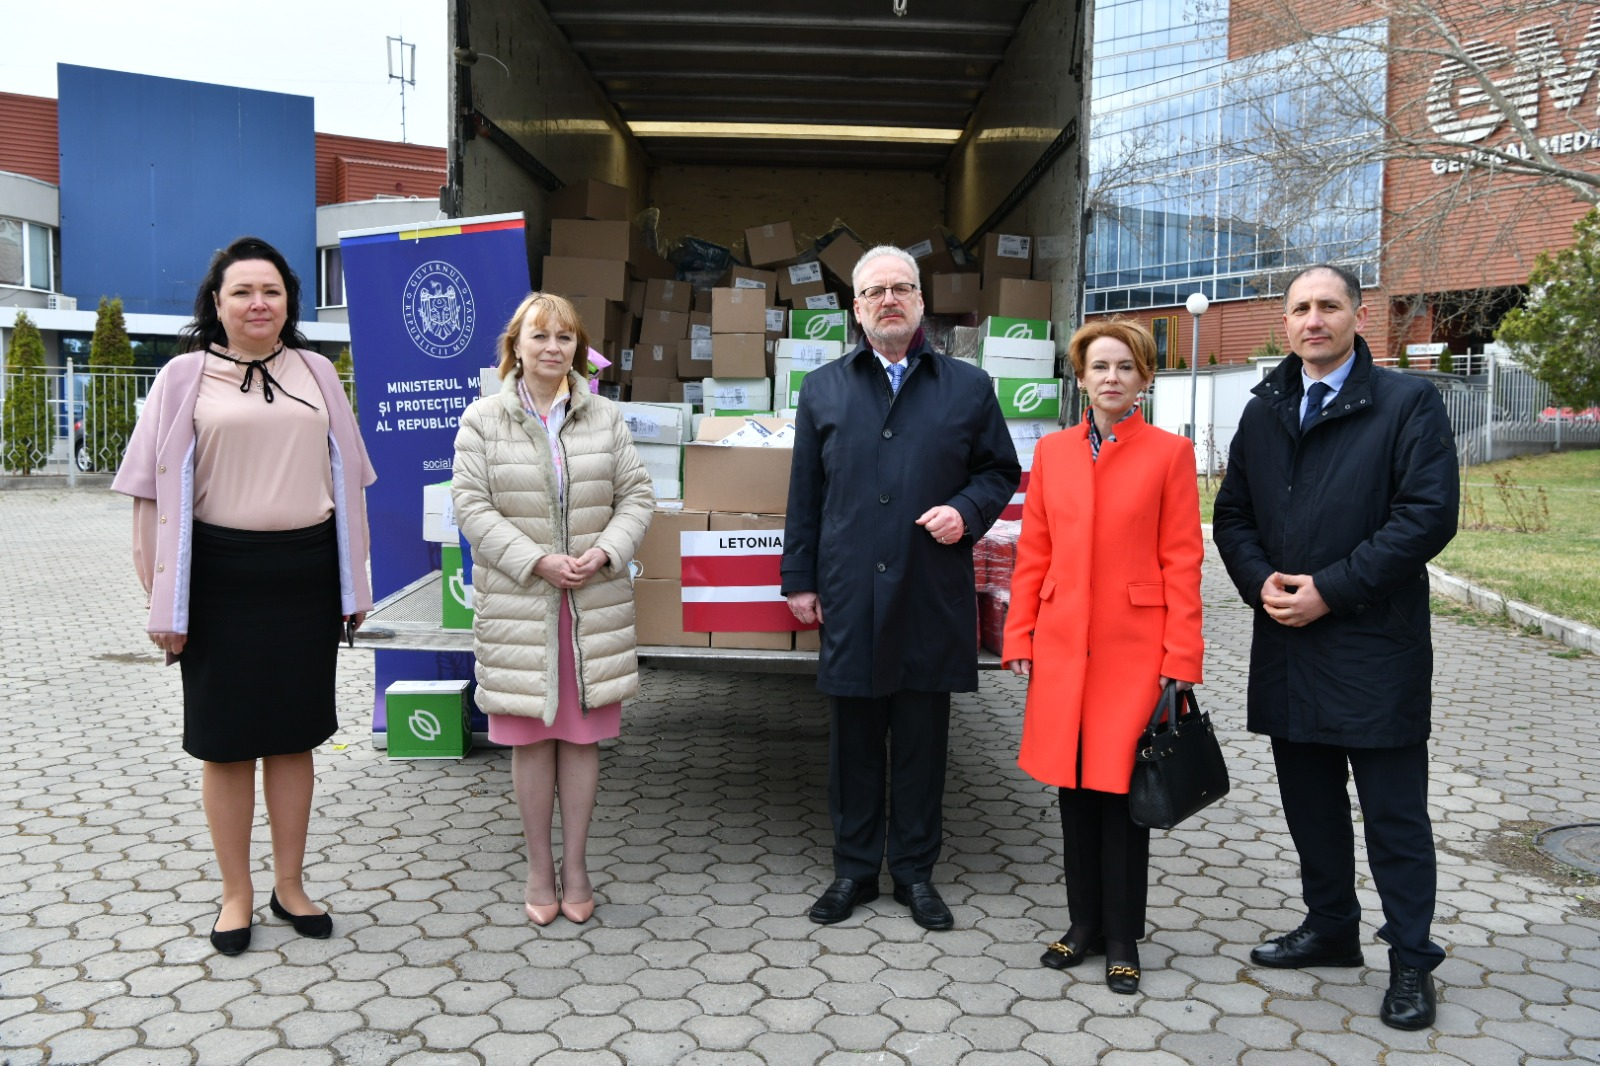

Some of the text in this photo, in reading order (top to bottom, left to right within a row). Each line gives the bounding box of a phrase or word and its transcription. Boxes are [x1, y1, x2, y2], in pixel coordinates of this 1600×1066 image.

[410, 263, 462, 287] GUVERNUL
[405, 299, 473, 356] REPUBLICII MOLDOVA
[387, 378, 463, 394] MINISTERUL
[396, 396, 467, 414] PROTECȚIEI
[375, 420, 393, 432] AL
[719, 536, 783, 549] LETONIA
